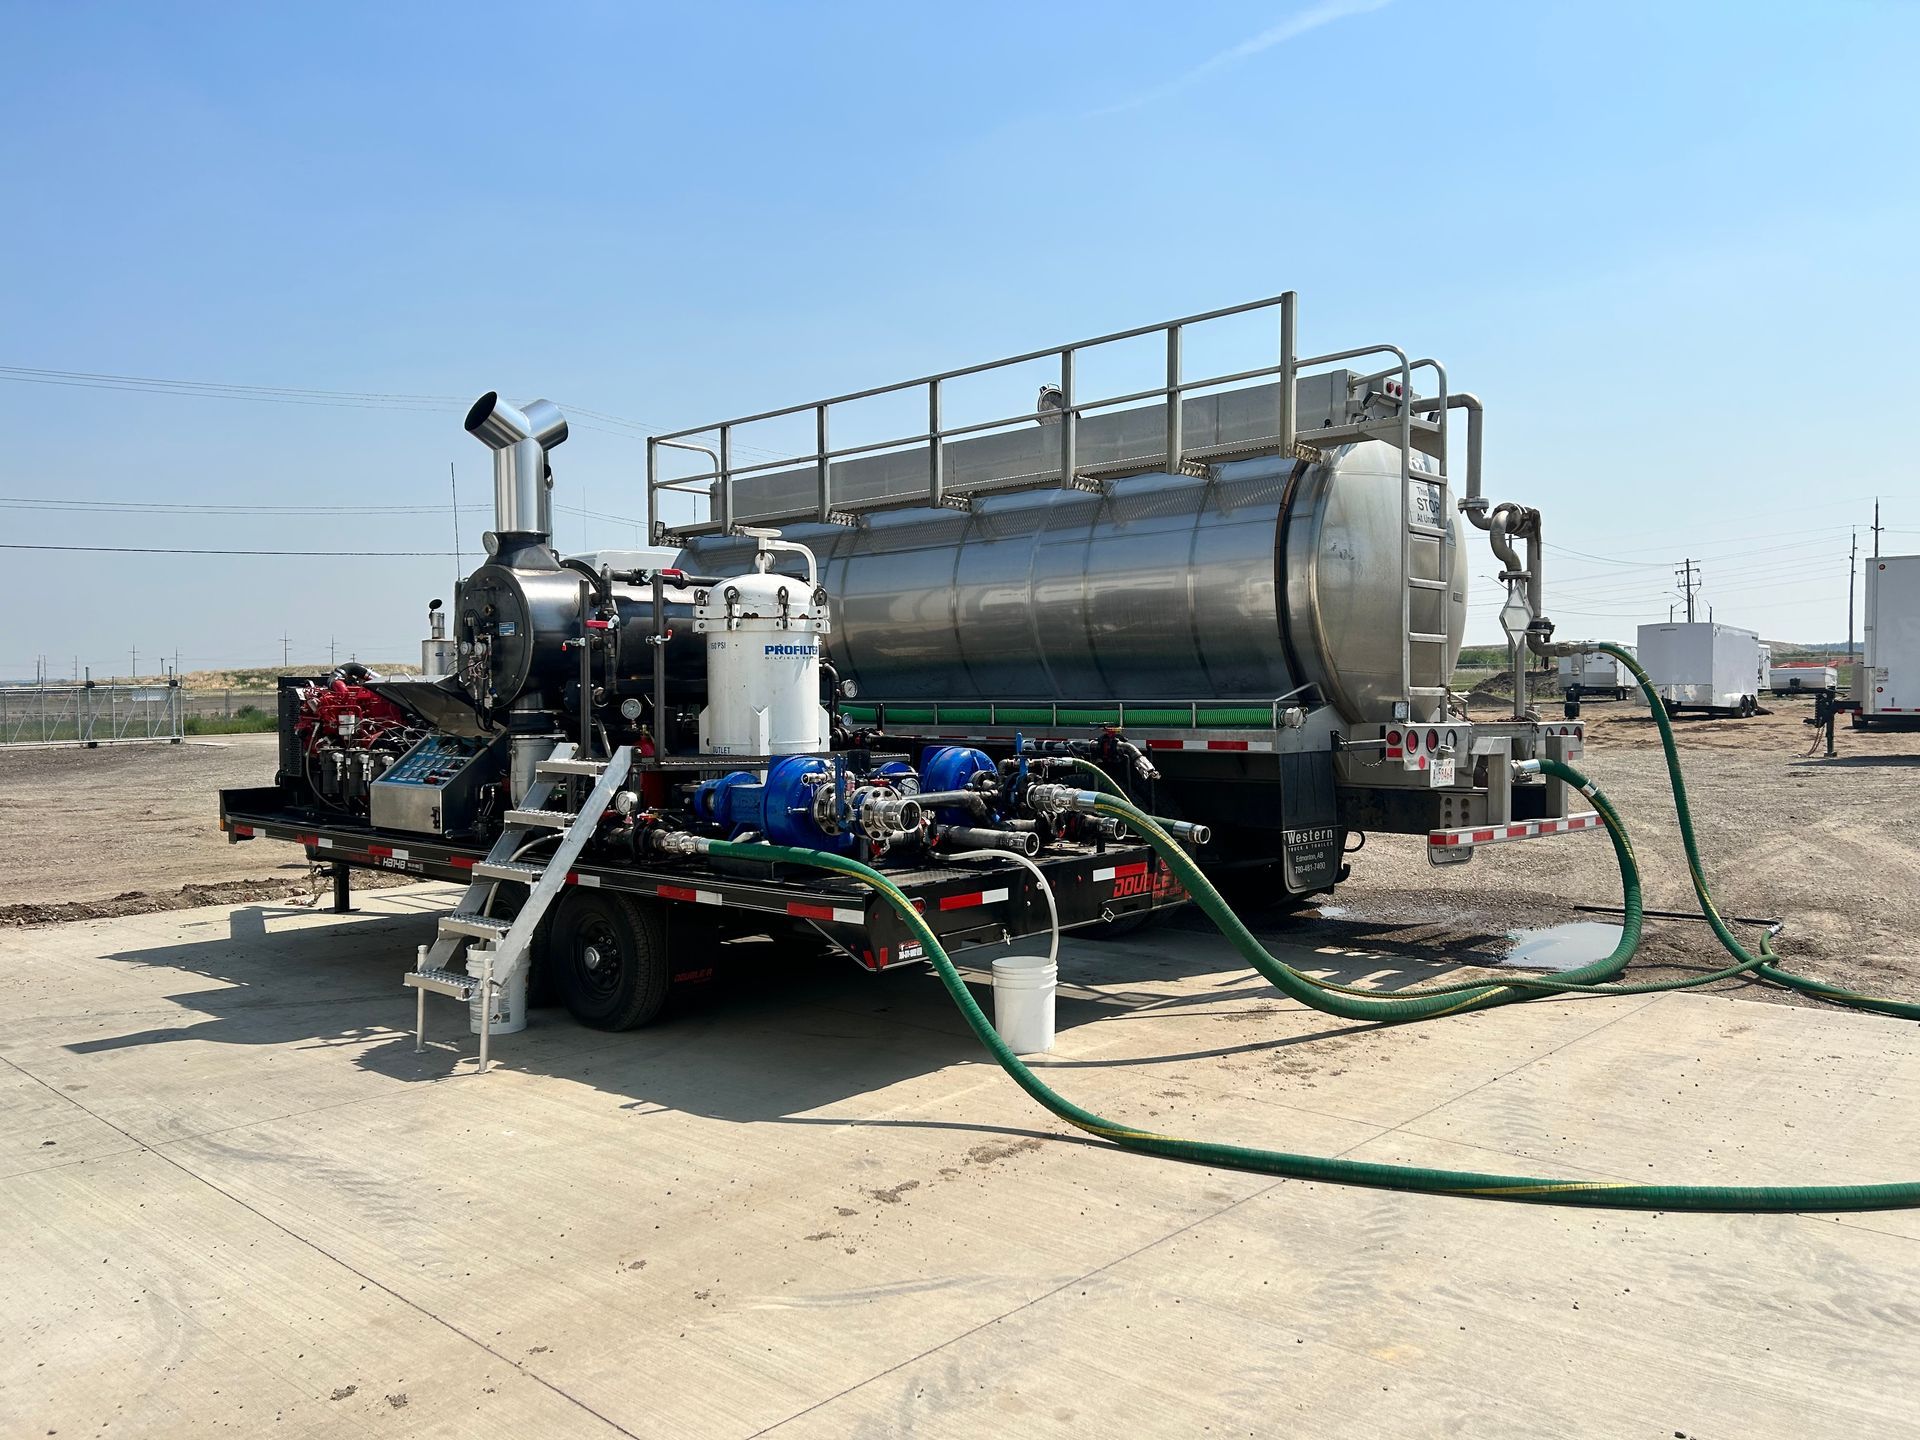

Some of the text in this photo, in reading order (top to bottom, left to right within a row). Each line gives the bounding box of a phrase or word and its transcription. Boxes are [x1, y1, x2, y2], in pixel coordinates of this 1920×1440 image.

[717, 641, 726, 650] PSI
[1287, 830, 1333, 844] Western
[1296, 851, 1324, 862] Edmonton, AB
[1113, 871, 1171, 898] DOUBLE
